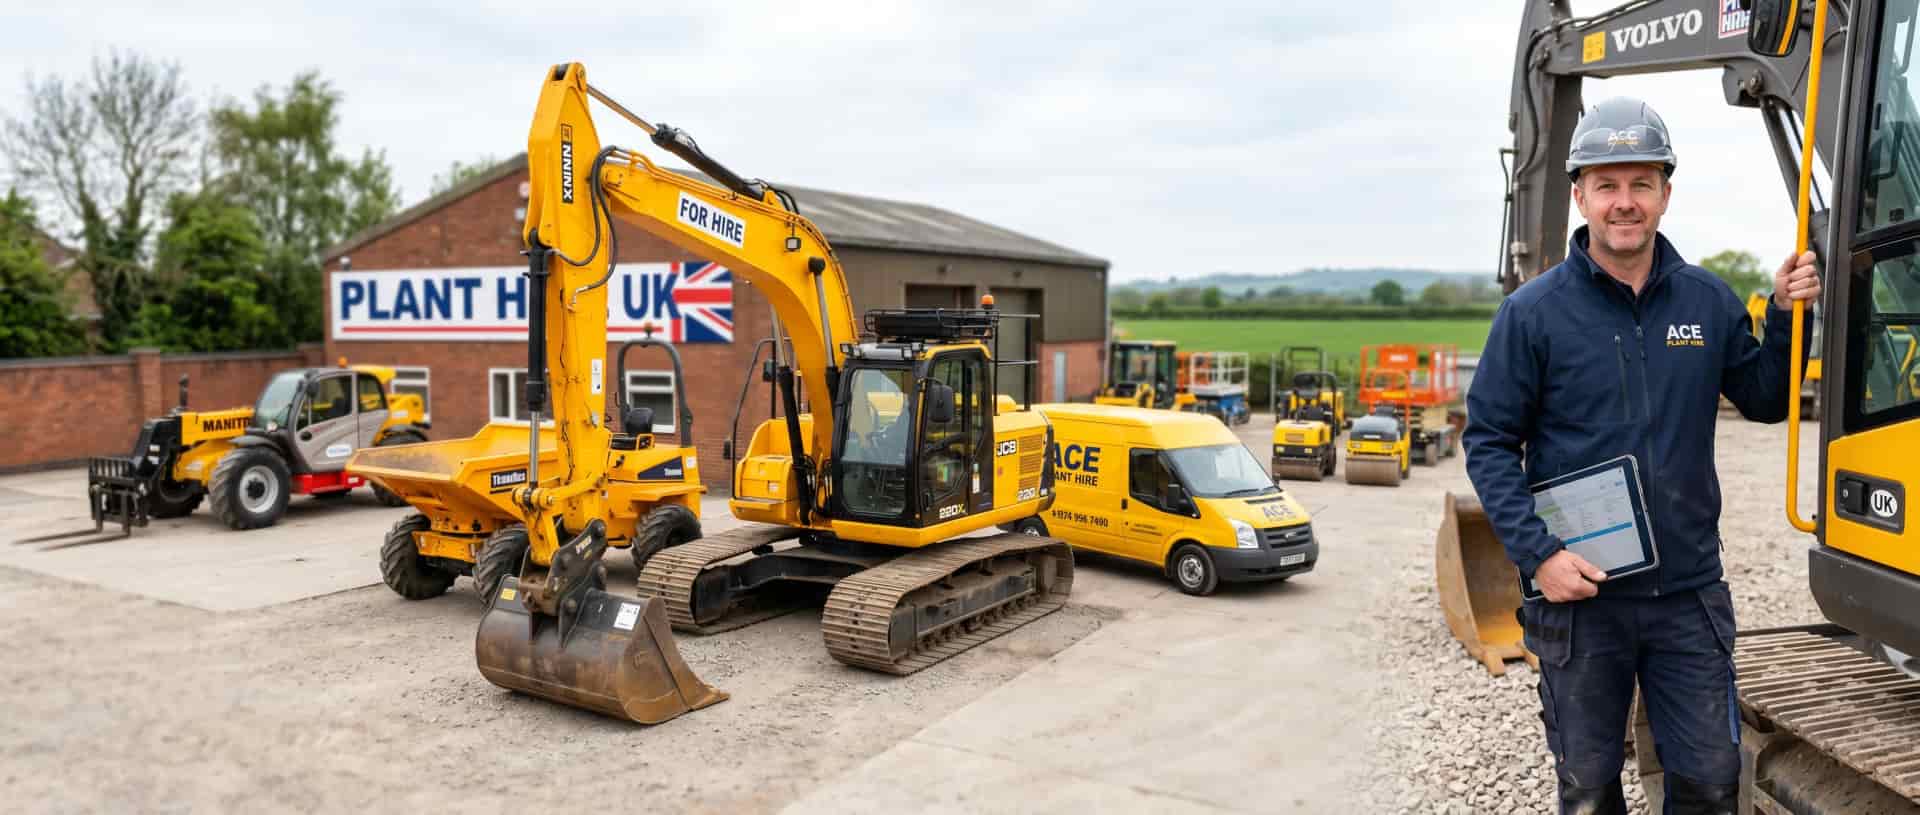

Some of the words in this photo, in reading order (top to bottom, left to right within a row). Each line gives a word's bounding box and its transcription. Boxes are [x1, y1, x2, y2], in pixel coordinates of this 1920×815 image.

[1611, 9, 1703, 52] VOLVO
[680, 198, 708, 228] FOR
[711, 212, 743, 243] HIRE
[340, 278, 483, 321] PLANT
[623, 273, 681, 321] UK
[1667, 324, 1703, 339] ACE
[997, 440, 1016, 456] JCB
[1055, 471, 1073, 482] ANT
[1075, 474, 1099, 487] HIRE
[1873, 493, 1894, 514] UK
